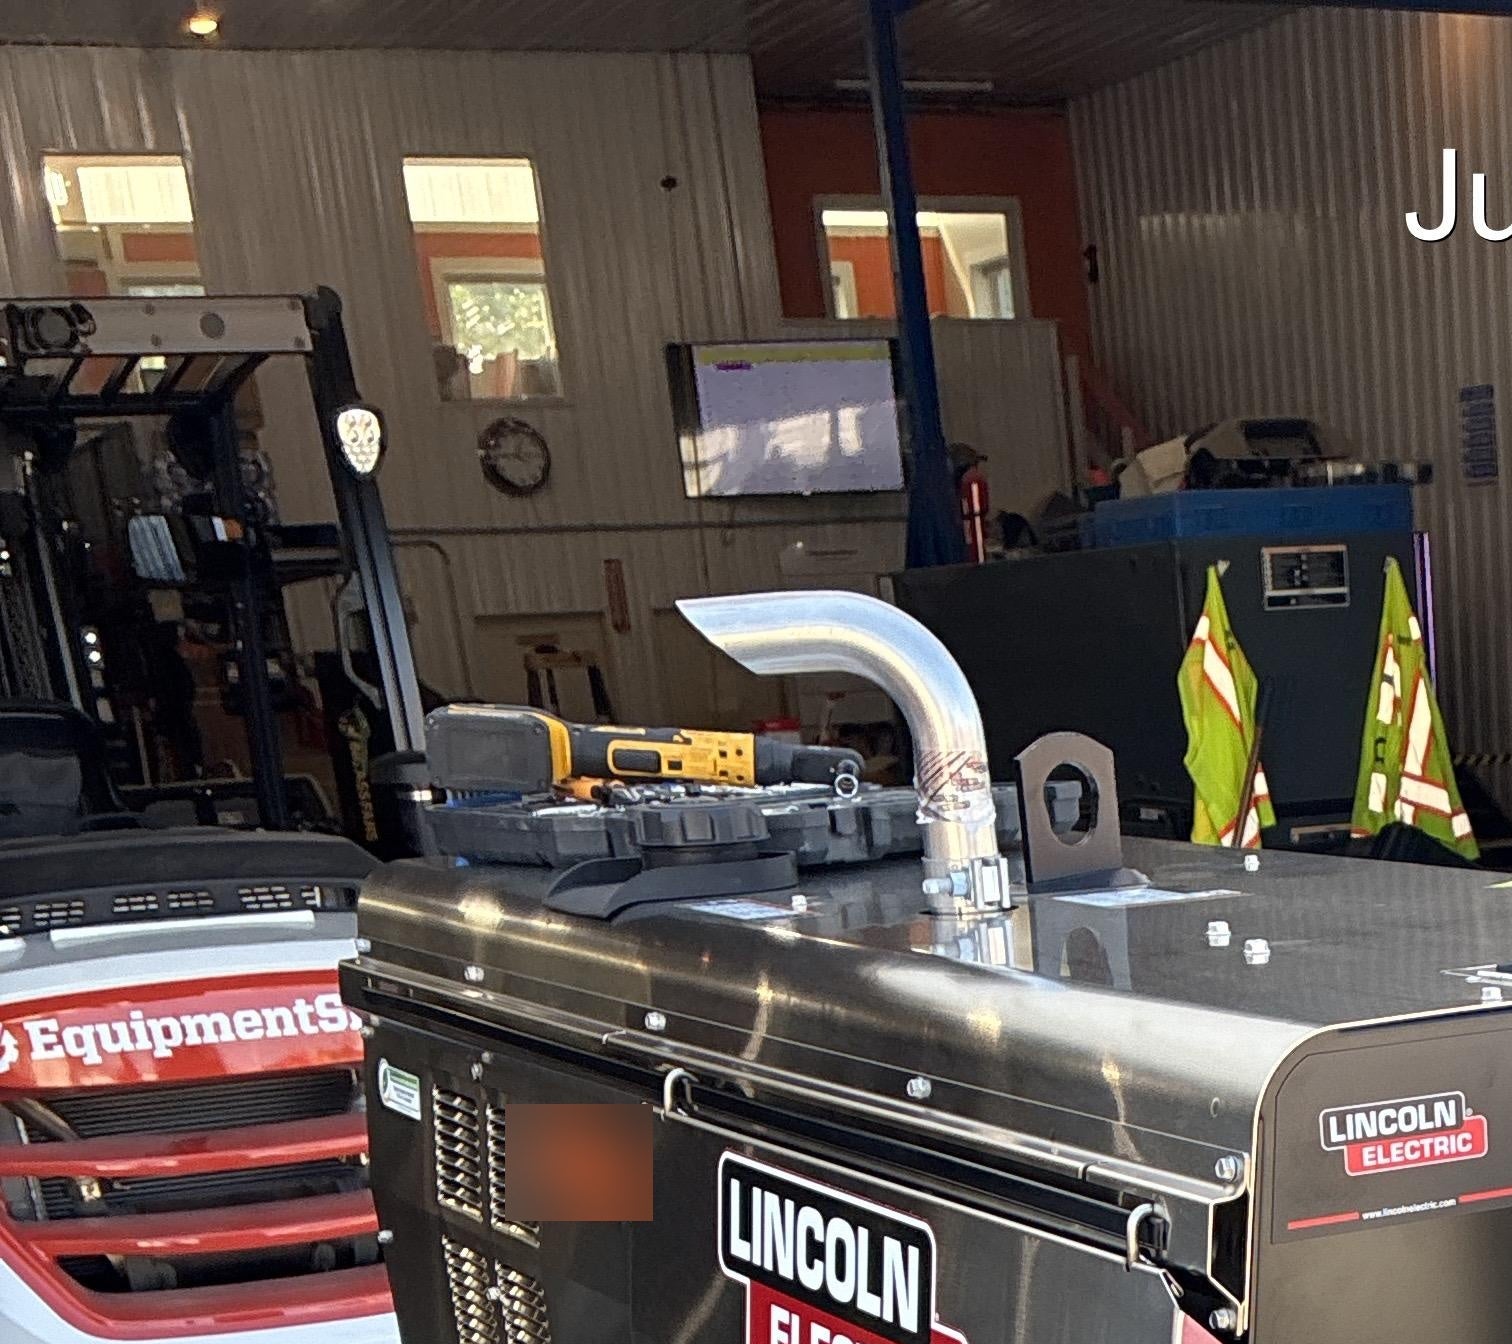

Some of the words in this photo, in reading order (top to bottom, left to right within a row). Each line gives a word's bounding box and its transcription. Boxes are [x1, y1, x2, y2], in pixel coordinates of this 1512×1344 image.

[1329, 1099, 1457, 1143] LINCOLN
[1361, 1132, 1473, 1167] ELECTRIC
[1361, 1198, 1457, 1221] www.lincolnelectric.com
[730, 1178, 920, 1334] LINCOLN
